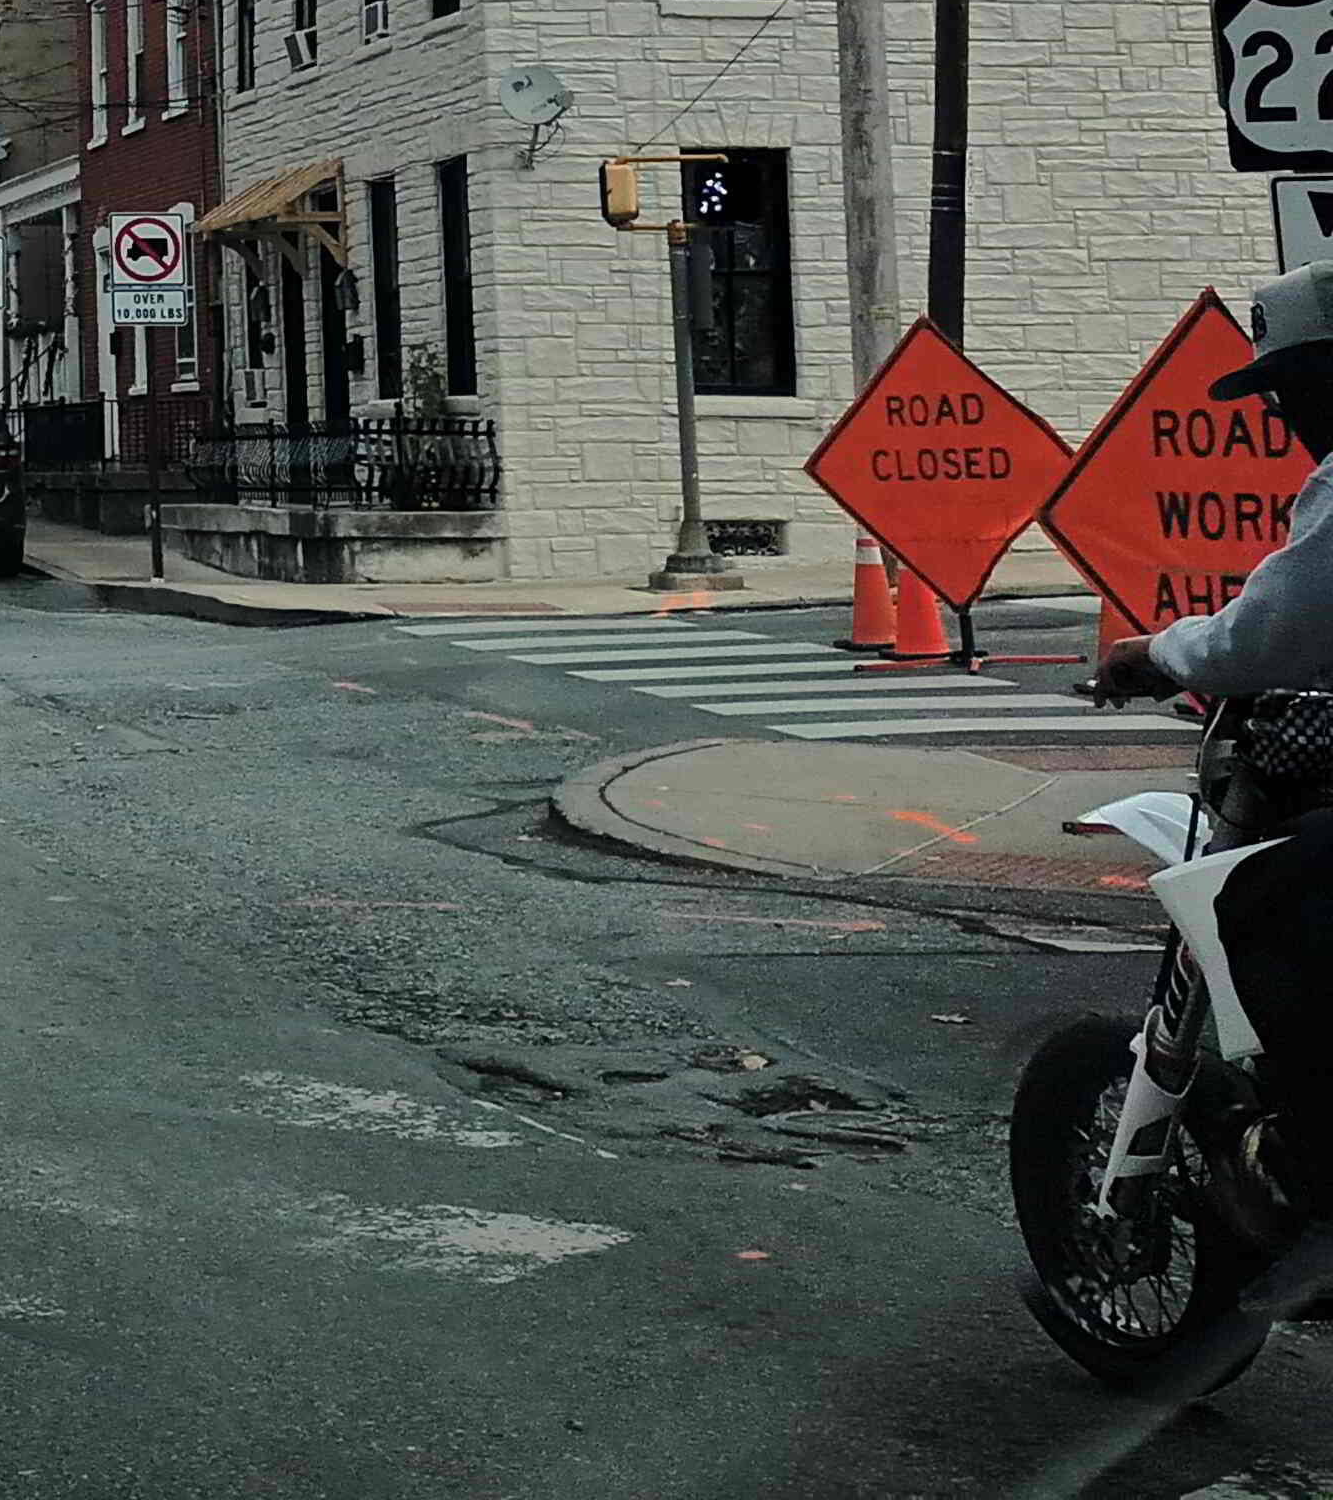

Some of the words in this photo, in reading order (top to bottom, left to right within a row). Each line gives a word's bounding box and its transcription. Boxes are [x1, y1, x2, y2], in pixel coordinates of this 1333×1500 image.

[116, 307, 156, 320] 10,000
[160, 307, 183, 319] LBS
[133, 293, 165, 305] OVER
[886, 393, 985, 427] ROAD
[1152, 408, 1292, 458] ROAD
[871, 447, 1012, 482] CLOSED
[1155, 491, 1300, 542] WORK
